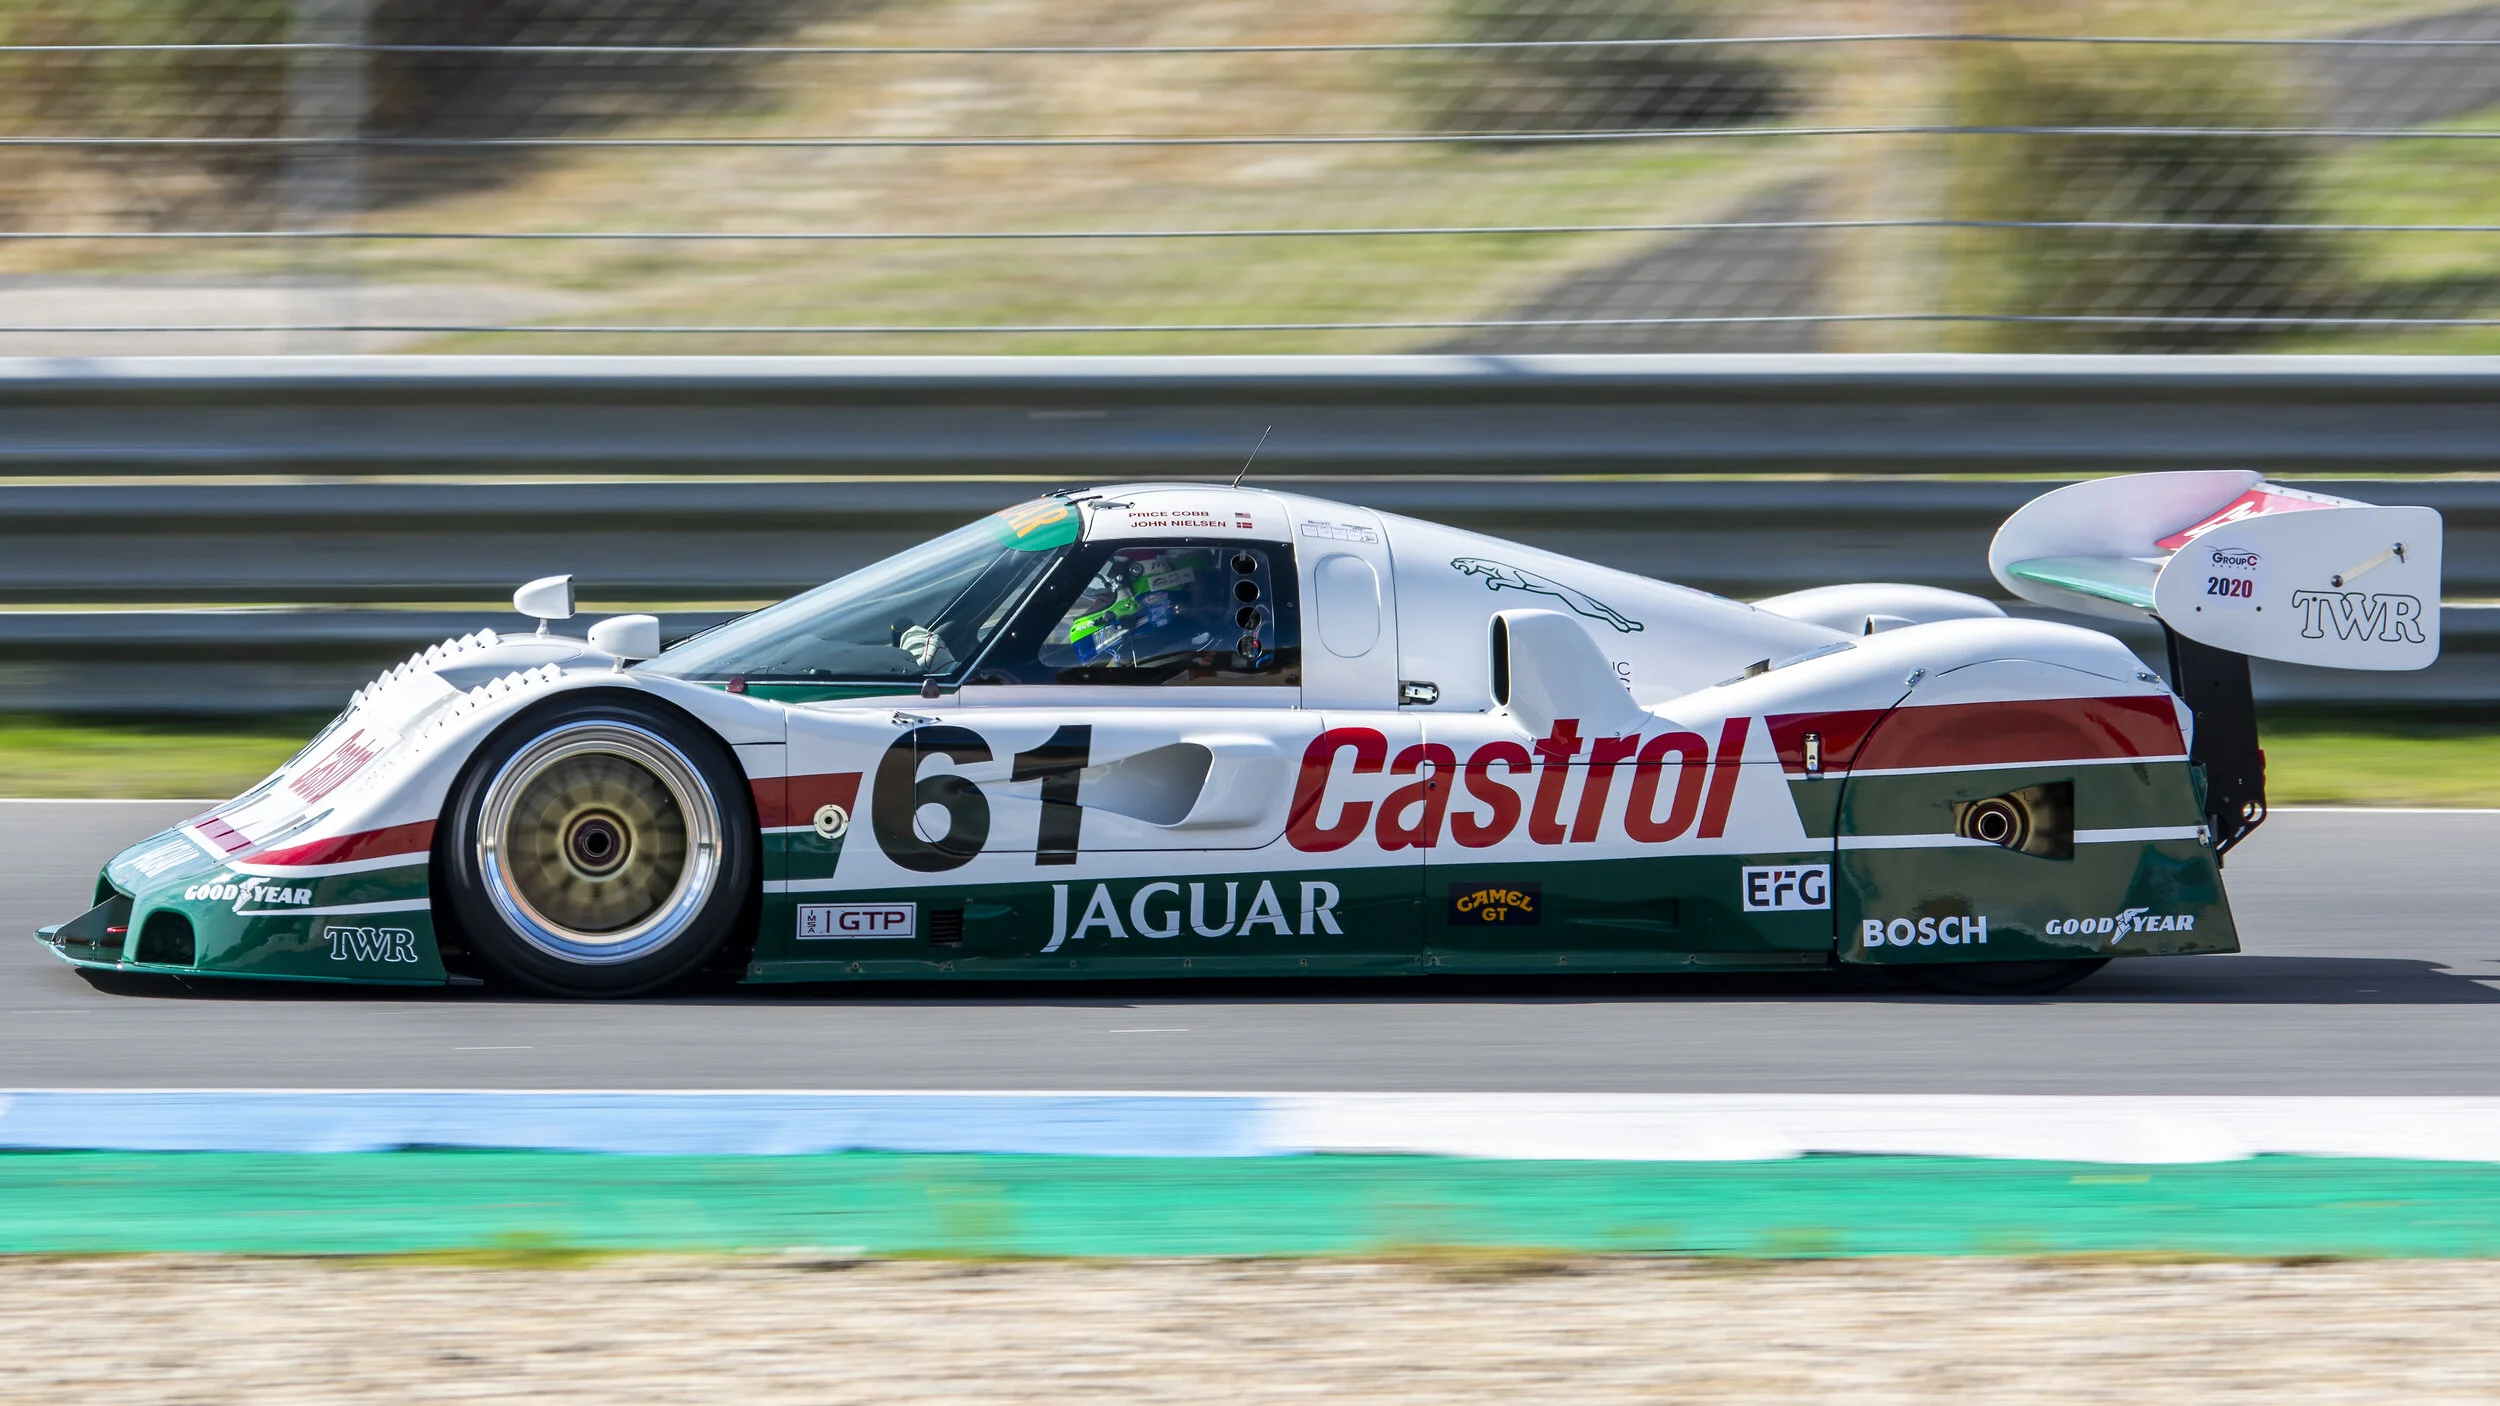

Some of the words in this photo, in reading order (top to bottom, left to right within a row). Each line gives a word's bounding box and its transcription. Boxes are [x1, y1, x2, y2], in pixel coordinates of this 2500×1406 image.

[1171, 520, 1226, 528] NIELSEN
[2207, 576, 2253, 598] 2020
[2292, 590, 2426, 644] TWR
[288, 728, 385, 804] Castrol
[873, 724, 1094, 873] 61
[1285, 717, 1751, 853] Castrol
[1457, 889, 1533, 912] CAMEL
[1751, 871, 1825, 906] EFG
[807, 909, 817, 934] IMSA
[839, 911, 906, 931] GTP
[1040, 881, 1344, 953] JAGUAR
[1482, 907, 1507, 922] GT
[324, 925, 418, 963] TWR
[1863, 916, 1987, 947] BOSCH
